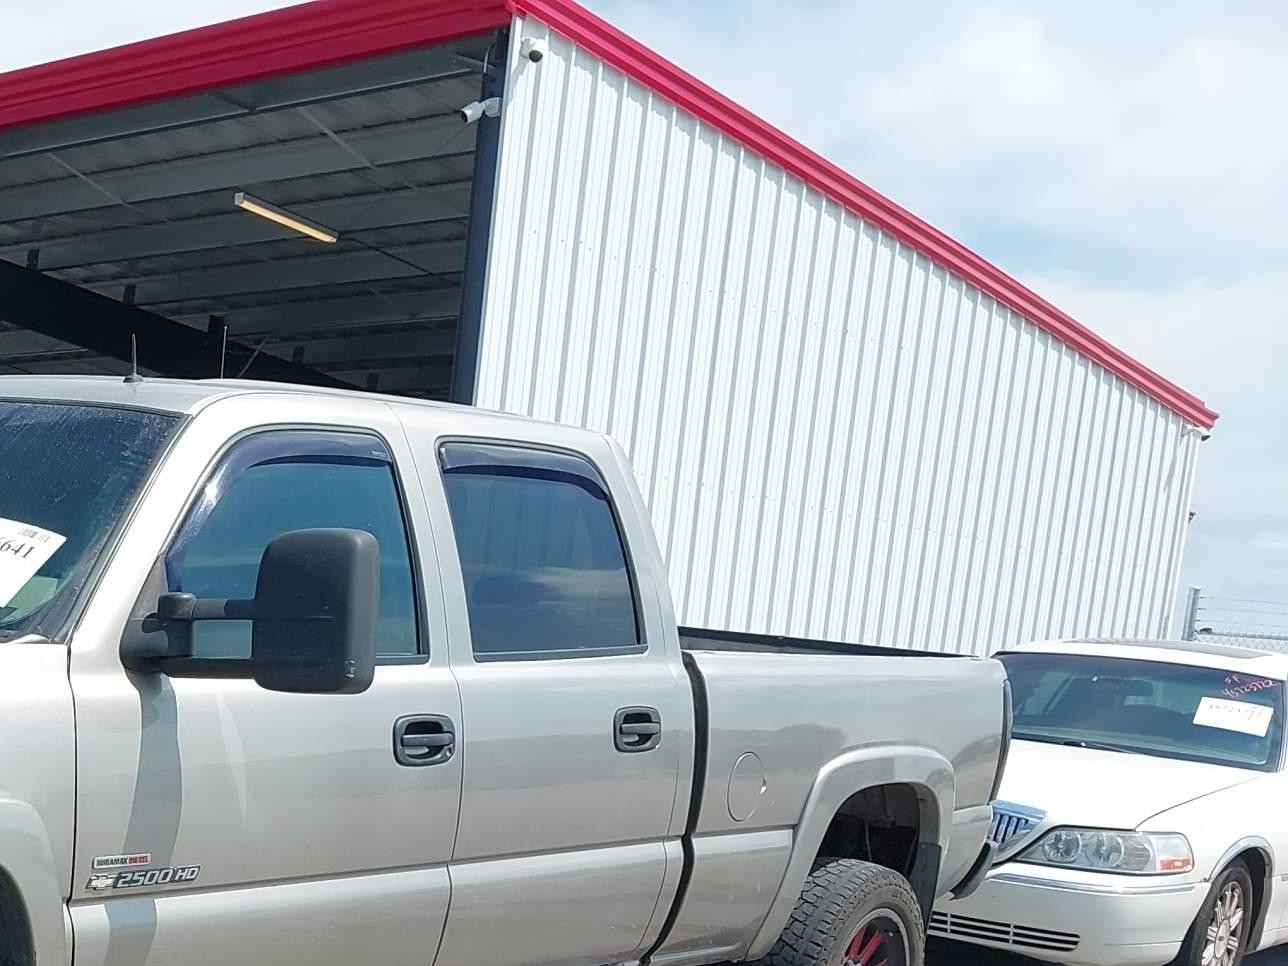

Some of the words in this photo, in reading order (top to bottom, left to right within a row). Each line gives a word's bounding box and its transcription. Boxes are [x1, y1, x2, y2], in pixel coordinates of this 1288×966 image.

[128, 855, 149, 865] DIESEL
[116, 868, 173, 888] 2500
[175, 867, 199, 881] HD
